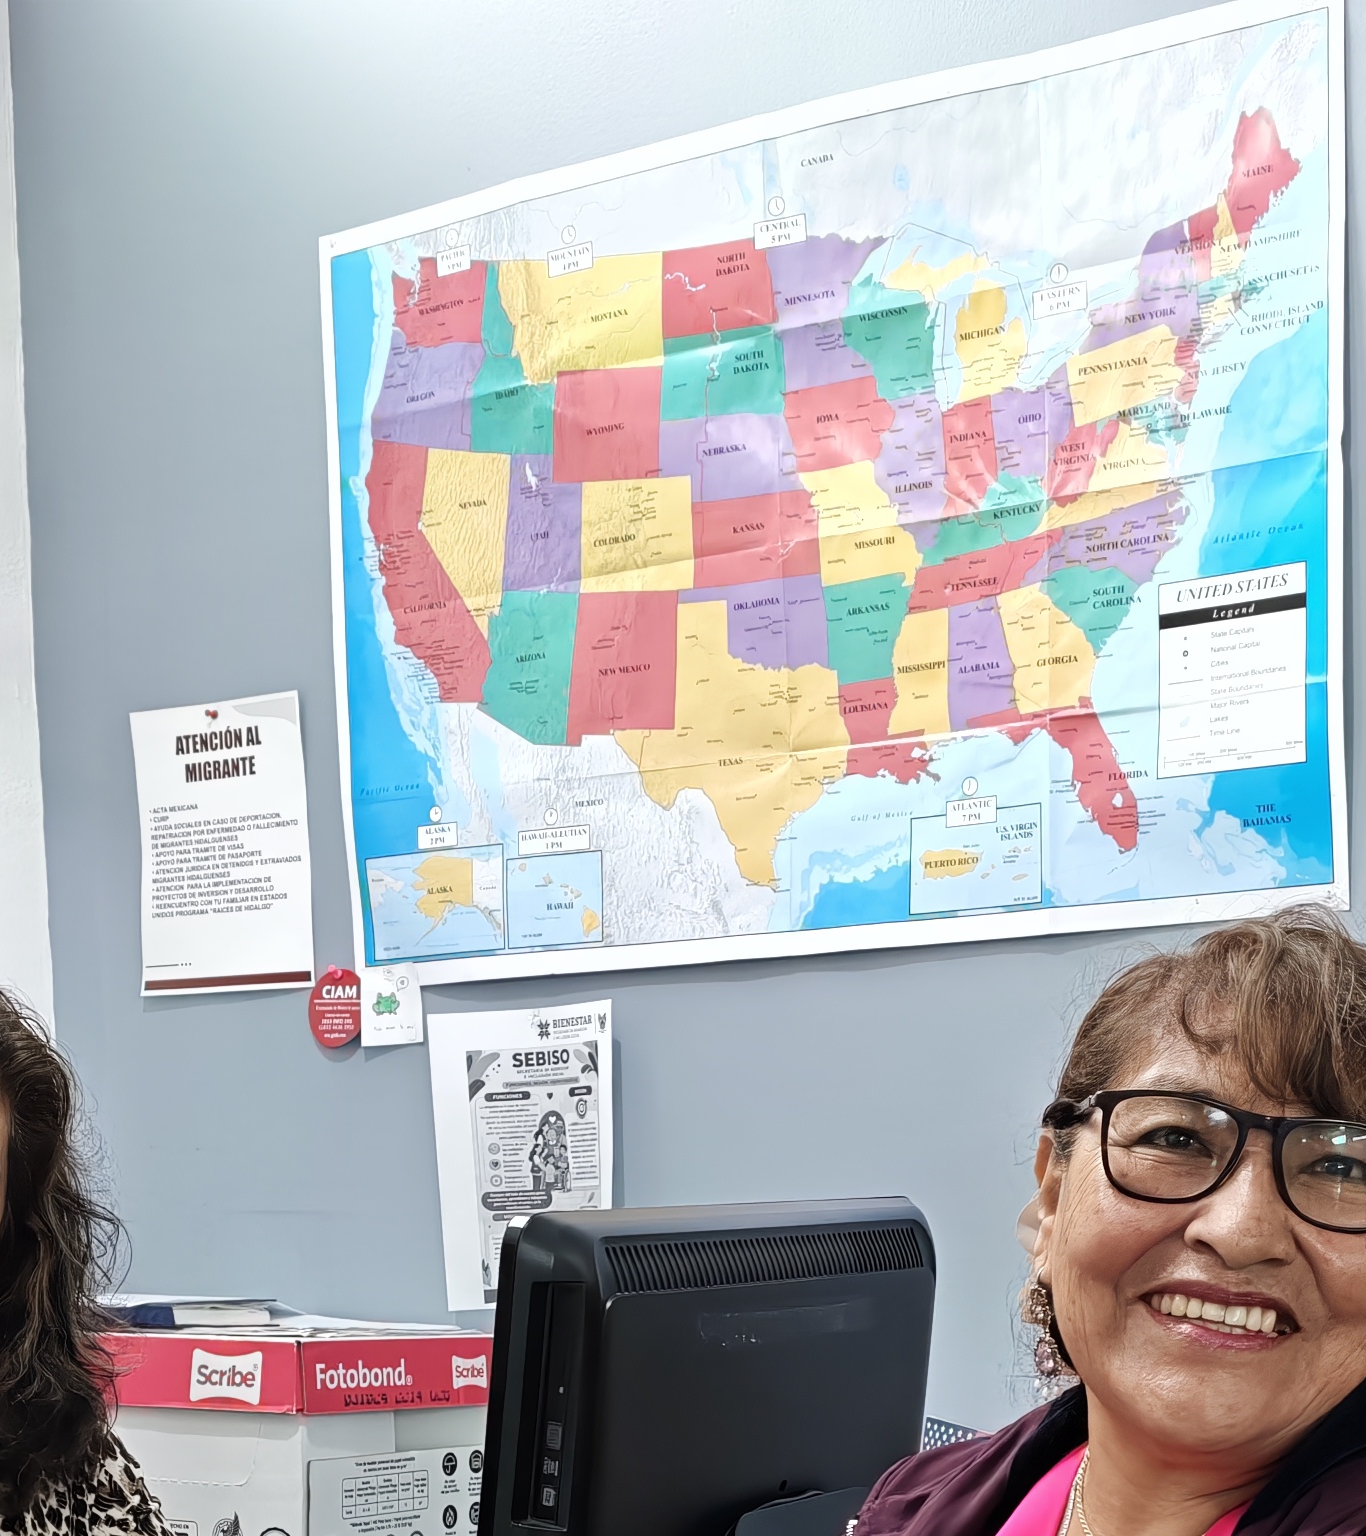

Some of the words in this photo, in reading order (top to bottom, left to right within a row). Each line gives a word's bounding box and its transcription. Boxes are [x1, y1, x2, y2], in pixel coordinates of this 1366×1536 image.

[801, 153, 834, 168] CANADA
[760, 219, 801, 233] CENTRAL
[717, 252, 746, 264] NORTH
[716, 263, 750, 277] DAKOTA
[784, 290, 836, 307] MINNESOTA
[418, 299, 464, 316] WASHINGTON
[590, 308, 628, 324] MONTANA
[858, 307, 908, 322] WISCONSIN
[1124, 310, 1146, 324] NEW
[1148, 307, 1177, 320] YORK
[959, 325, 1006, 342] MICHIGAN
[734, 351, 764, 363] SOUTH
[733, 361, 770, 375] DAKOTA
[1078, 356, 1148, 376] PENNSYLVANIA
[406, 390, 435, 403] OREGON
[495, 388, 519, 400] IDAHO
[1117, 401, 1171, 419] MARYLAND
[816, 413, 839, 424] IOWA
[1018, 413, 1042, 425] OHIO
[586, 422, 624, 437] WYOMING
[949, 430, 986, 443] INDIANA
[702, 444, 747, 458] NEBRASKA
[1060, 442, 1086, 453] WEST
[1053, 454, 1096, 467] VIRGINIA
[895, 480, 933, 494] ILLINOIS
[458, 499, 487, 510] NEVADA
[993, 503, 1041, 520] KENTUCKY
[732, 522, 765, 534] KANSAS
[593, 533, 636, 548] COLORADO
[854, 536, 895, 550] MISSOURI
[1086, 539, 1119, 553] NORTH
[1120, 533, 1169, 549] CAROLINA
[950, 577, 999, 593] TENNESSEE
[1093, 585, 1124, 597] SOUTH
[1177, 583, 1233, 603] UNITED
[1235, 573, 1288, 594] STATES
[404, 600, 447, 614] CALIFORNIA
[733, 597, 780, 611] OKLAHOMA
[846, 603, 890, 617] ARKANSAS
[1213, 603, 1255, 619] Legend
[515, 651, 546, 664] ARIZONA
[1036, 654, 1078, 667] GEORGIA
[598, 667, 616, 676] NEW
[618, 663, 650, 675] MEXICO
[897, 661, 945, 674] MISSISSIPPI
[958, 661, 999, 674] ALABAMA
[843, 702, 889, 715] LOUISIANA
[175, 727, 243, 756] ATENCIÓN
[246, 725, 262, 747] AL
[718, 756, 743, 767] TEXAS
[184, 755, 256, 783] MIGRANTE
[1108, 769, 1148, 781] FLORIDA
[575, 798, 604, 808] MEXICO
[950, 800, 991, 811] ATLANTIC
[1256, 804, 1276, 813] THE
[1011, 822, 1038, 832] VIRGIN
[1243, 814, 1292, 827] BAHAMAS
[425, 826, 451, 835] ALASKA
[1000, 830, 1033, 840] ISLANDS
[924, 858, 955, 870] PUERTO
[958, 856, 979, 867] RICO
[427, 885, 453, 896] ALASKA
[322, 985, 356, 998] CIAM
[553, 1015, 592, 1028] BIENESTAR
[512, 1049, 569, 1067] SEBISO
[196, 1364, 256, 1388] Scribe
[316, 1358, 405, 1390] Fotobond
[455, 1365, 484, 1378] Scribe
